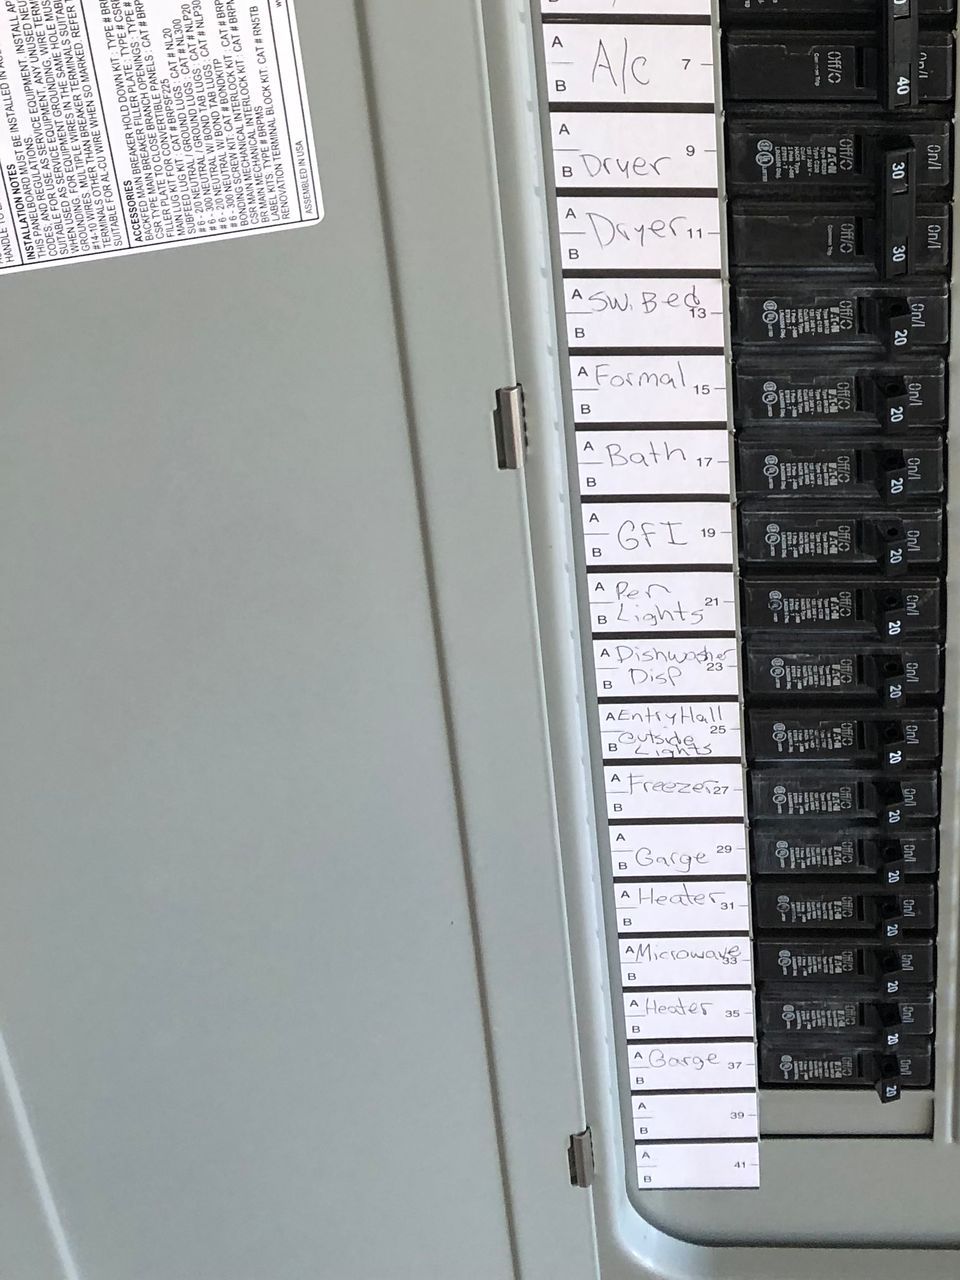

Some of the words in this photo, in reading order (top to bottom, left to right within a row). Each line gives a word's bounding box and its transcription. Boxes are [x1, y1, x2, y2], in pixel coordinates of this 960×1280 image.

[591, 36, 650, 95] A/C
[681, 58, 691, 70] 7
[896, 75, 910, 96] 40
[295, 141, 304, 157] USA
[685, 145, 696, 157] 9
[578, 152, 673, 179] Dryer
[892, 162, 905, 180] 30
[7, 164, 22, 195] NOTES
[300, 168, 312, 214] ASSEMBLED
[124, 180, 142, 243] ACCESSORIES
[13, 196, 36, 260] INSTALLATION
[585, 211, 687, 249] Dryer
[686, 229, 703, 239] 11
[892, 246, 906, 263] 30
[641, 285, 701, 309] Bed
[688, 308, 707, 319] 13
[594, 361, 687, 390] Formal
[693, 384, 711, 395] 15
[605, 440, 688, 468] Bath
[696, 457, 713, 468] 17
[700, 528, 717, 538] 19
[704, 597, 720, 607] 21
[616, 602, 704, 627] Lights
[706, 662, 724, 672] 23
[628, 667, 683, 687] Disp
[710, 726, 727, 735] 25
[628, 772, 720, 796] Freezer
[713, 785, 729, 795] 27
[717, 845, 732, 854] 29
[637, 883, 726, 906] Heater
[720, 902, 735, 911] 31
[635, 943, 742, 962] Microwave
[722, 956, 737, 965] 33
[645, 997, 714, 1017] Heater
[725, 1009, 740, 1018] 35
[727, 1061, 742, 1070] 37
[730, 1112, 745, 1120] 39
[734, 1161, 747, 1169] 41
